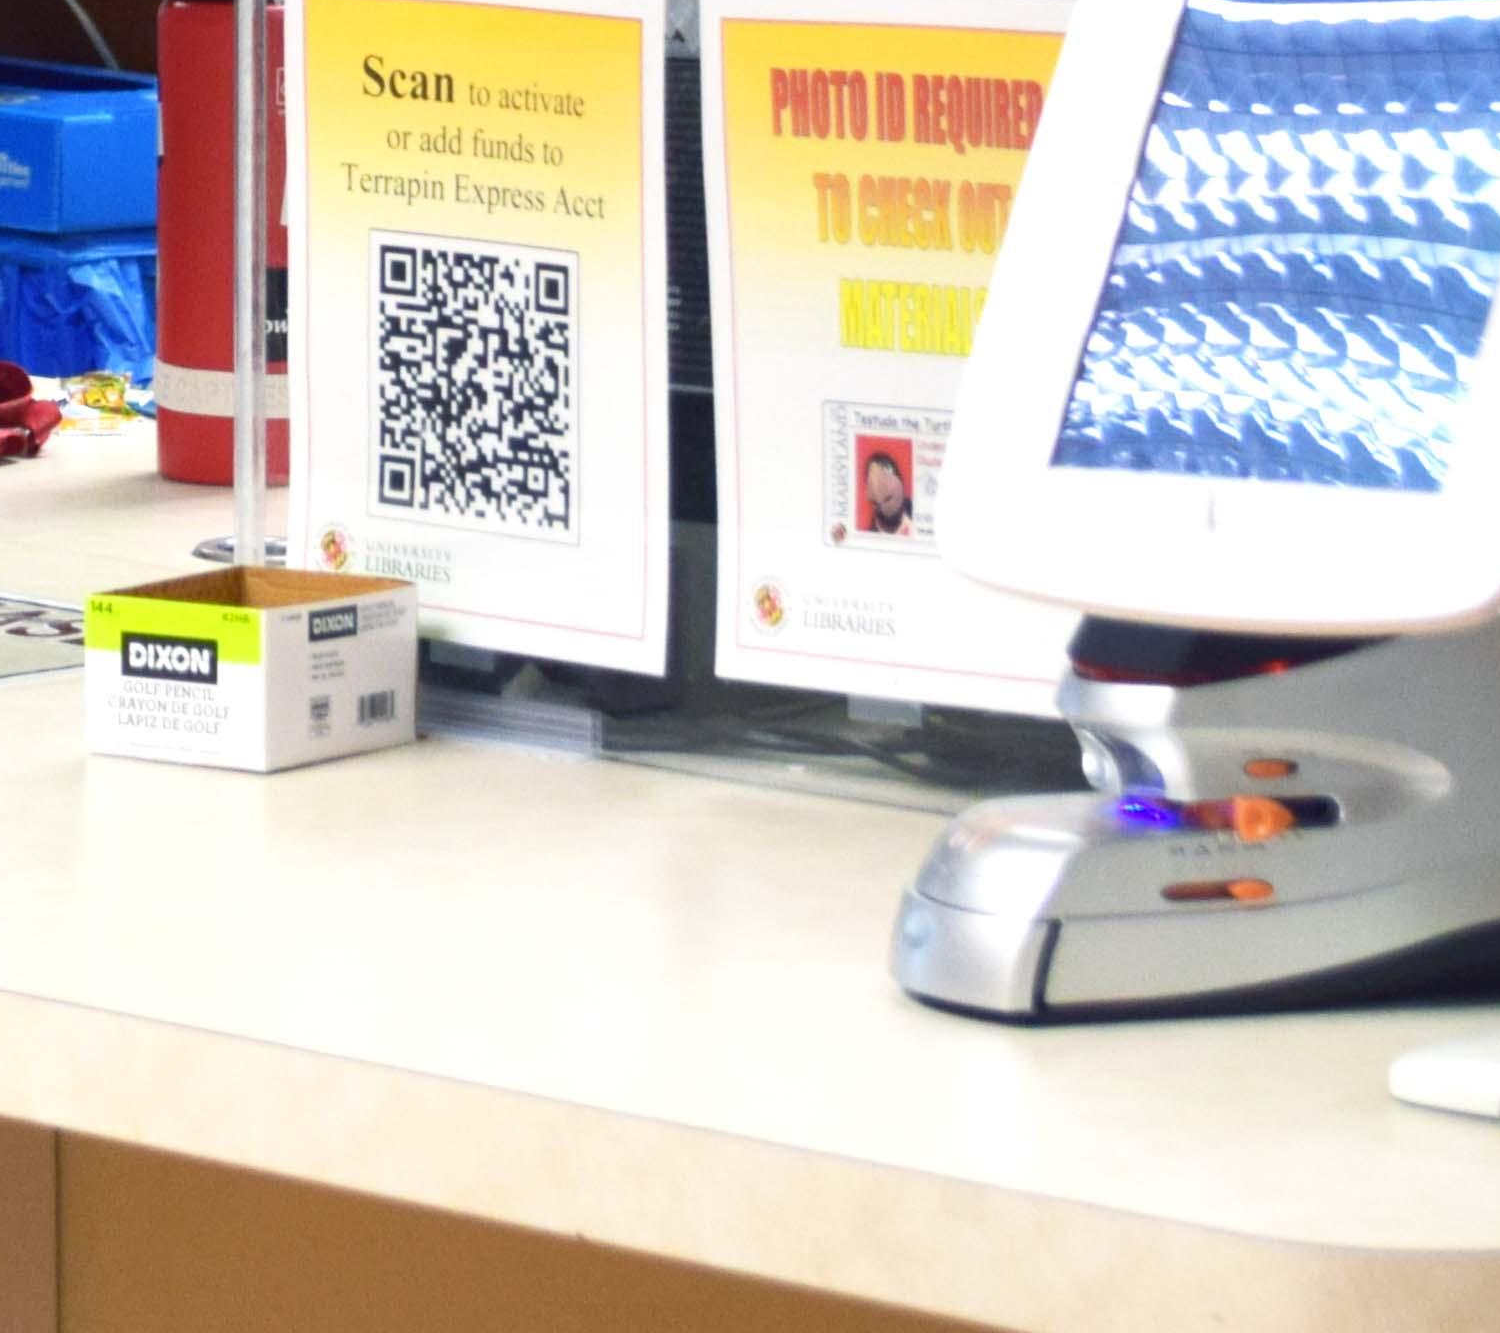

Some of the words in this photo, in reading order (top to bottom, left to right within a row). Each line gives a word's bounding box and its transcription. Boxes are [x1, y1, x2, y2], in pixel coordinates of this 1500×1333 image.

[362, 53, 455, 103] Scan
[468, 82, 491, 108] to
[499, 83, 585, 117] activate
[770, 67, 869, 142] PHOTO
[875, 71, 906, 143] ID
[386, 128, 411, 150] or
[419, 126, 463, 156] add
[472, 128, 535, 166] funds
[542, 143, 563, 167] to
[341, 162, 445, 206] Terrapin
[454, 173, 545, 214] Express
[554, 186, 606, 220] Acct
[813, 171, 850, 246] TO
[858, 173, 953, 252] CHECK
[958, 179, 1013, 255] OUT
[366, 555, 451, 583] LIBRARIES
[312, 612, 354, 635] DIXON
[803, 610, 896, 637] LIBRARIES
[128, 641, 211, 676] DIXON
[123, 679, 160, 696] GOLF
[165, 684, 215, 702] PENCIL
[107, 694, 167, 713] CRAYON
[172, 700, 188, 715] DE
[193, 702, 231, 721] GOLF
[118, 712, 158, 729] LAPIZ
[162, 715, 179, 731] DE
[184, 717, 220, 735] GOLF
